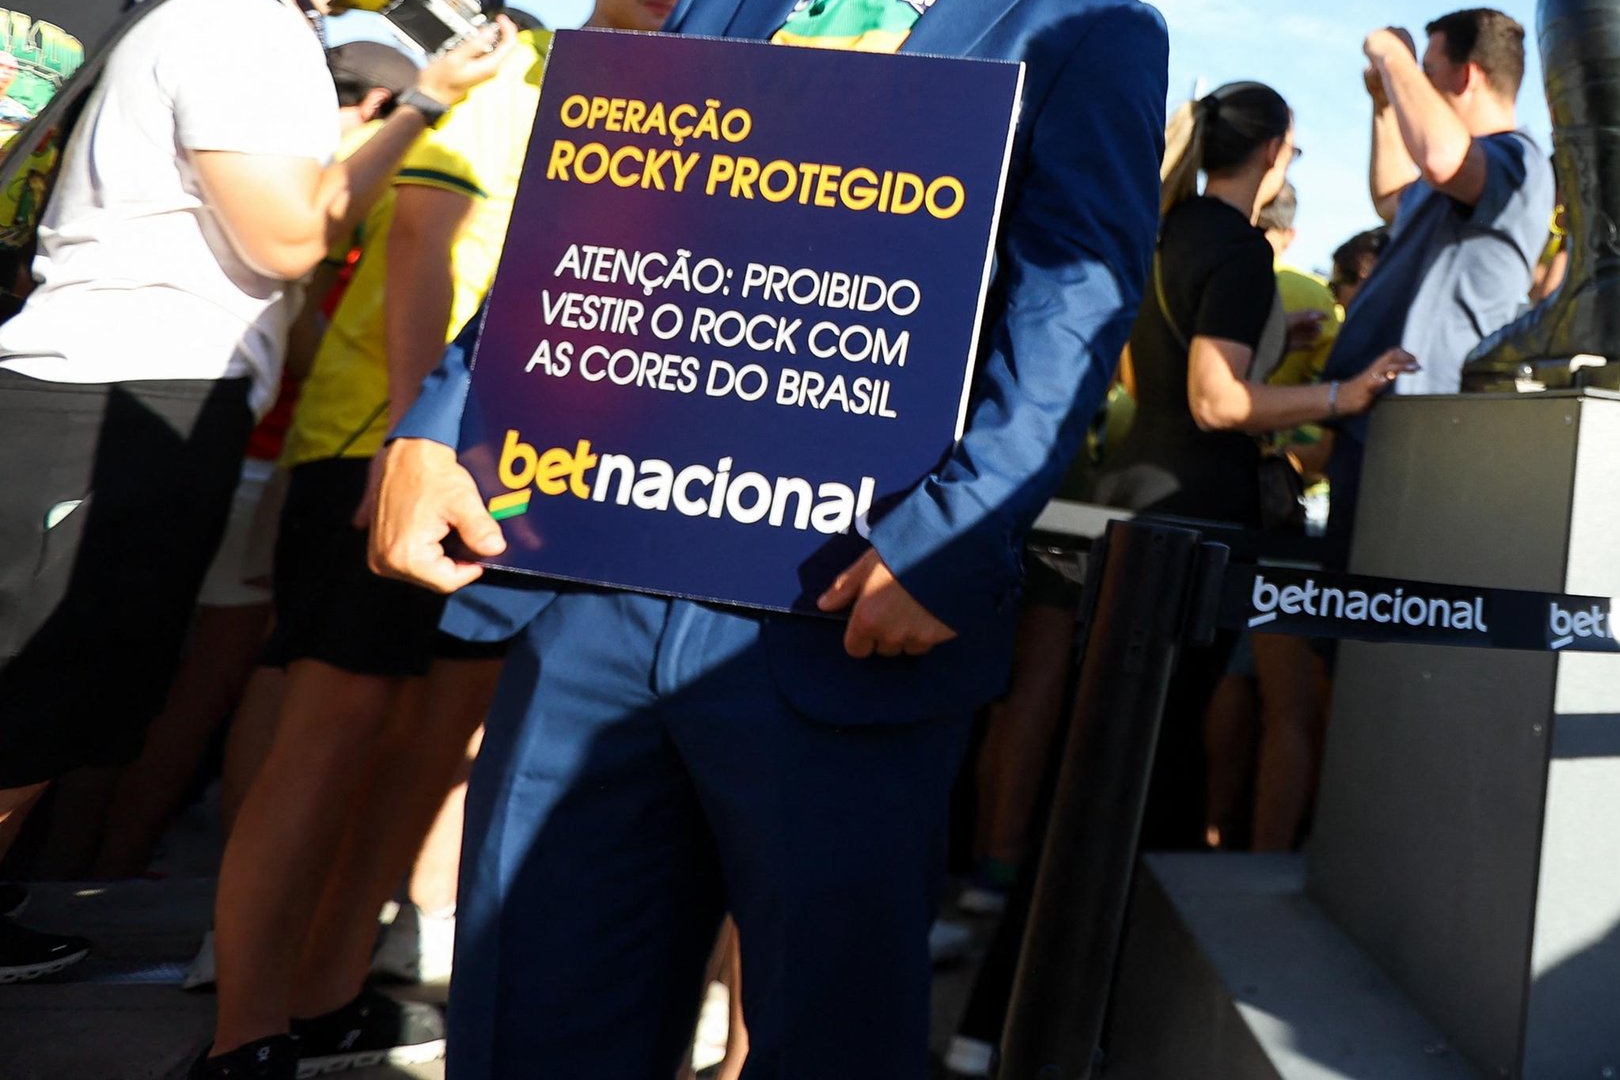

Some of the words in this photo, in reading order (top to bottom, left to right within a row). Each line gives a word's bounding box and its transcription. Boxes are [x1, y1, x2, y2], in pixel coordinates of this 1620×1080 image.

[561, 95, 751, 146] OPERAÇÃO
[547, 140, 700, 192] ROCKY
[706, 155, 964, 218] PROTEGIDO
[554, 244, 733, 295] ATENÇÃO:
[742, 263, 920, 315] PROIBIDO
[543, 290, 644, 335] VESTIR
[651, 304, 683, 339] O
[690, 308, 802, 354] ROCK
[808, 322, 909, 366] COM
[525, 340, 573, 377] AS
[580, 346, 699, 393] CORES
[706, 360, 768, 401] DO
[776, 369, 896, 418] BRASIL
[499, 430, 875, 538] betnacional
[1251, 575, 1488, 632] betnacional
